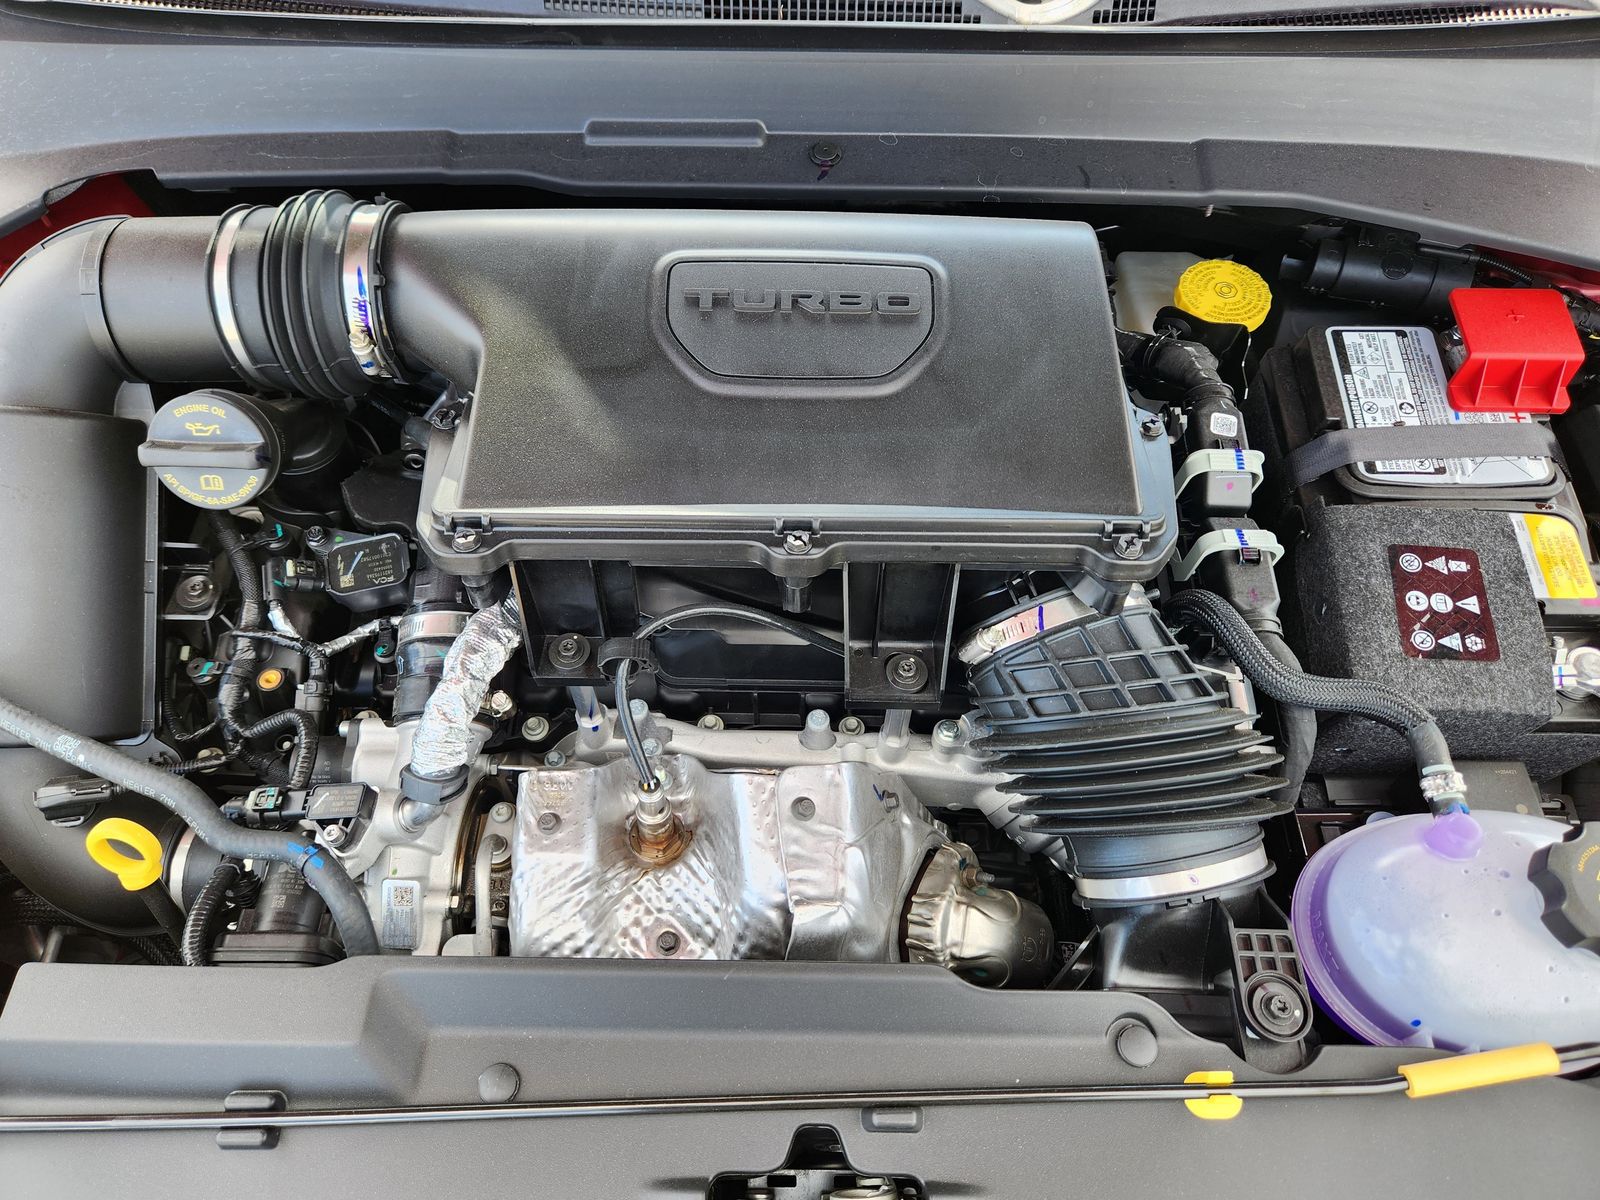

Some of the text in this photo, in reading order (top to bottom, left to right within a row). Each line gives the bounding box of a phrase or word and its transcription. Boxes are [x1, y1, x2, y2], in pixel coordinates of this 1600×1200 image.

[683, 287, 921, 315] TURBO
[1343, 374, 1364, 427] DANGER/POISON
[173, 404, 209, 417] ENGINE
[211, 406, 226, 418] OIL
[162, 473, 178, 488] API
[372, 574, 396, 584] FCA
[123, 778, 156, 796] HEATER
